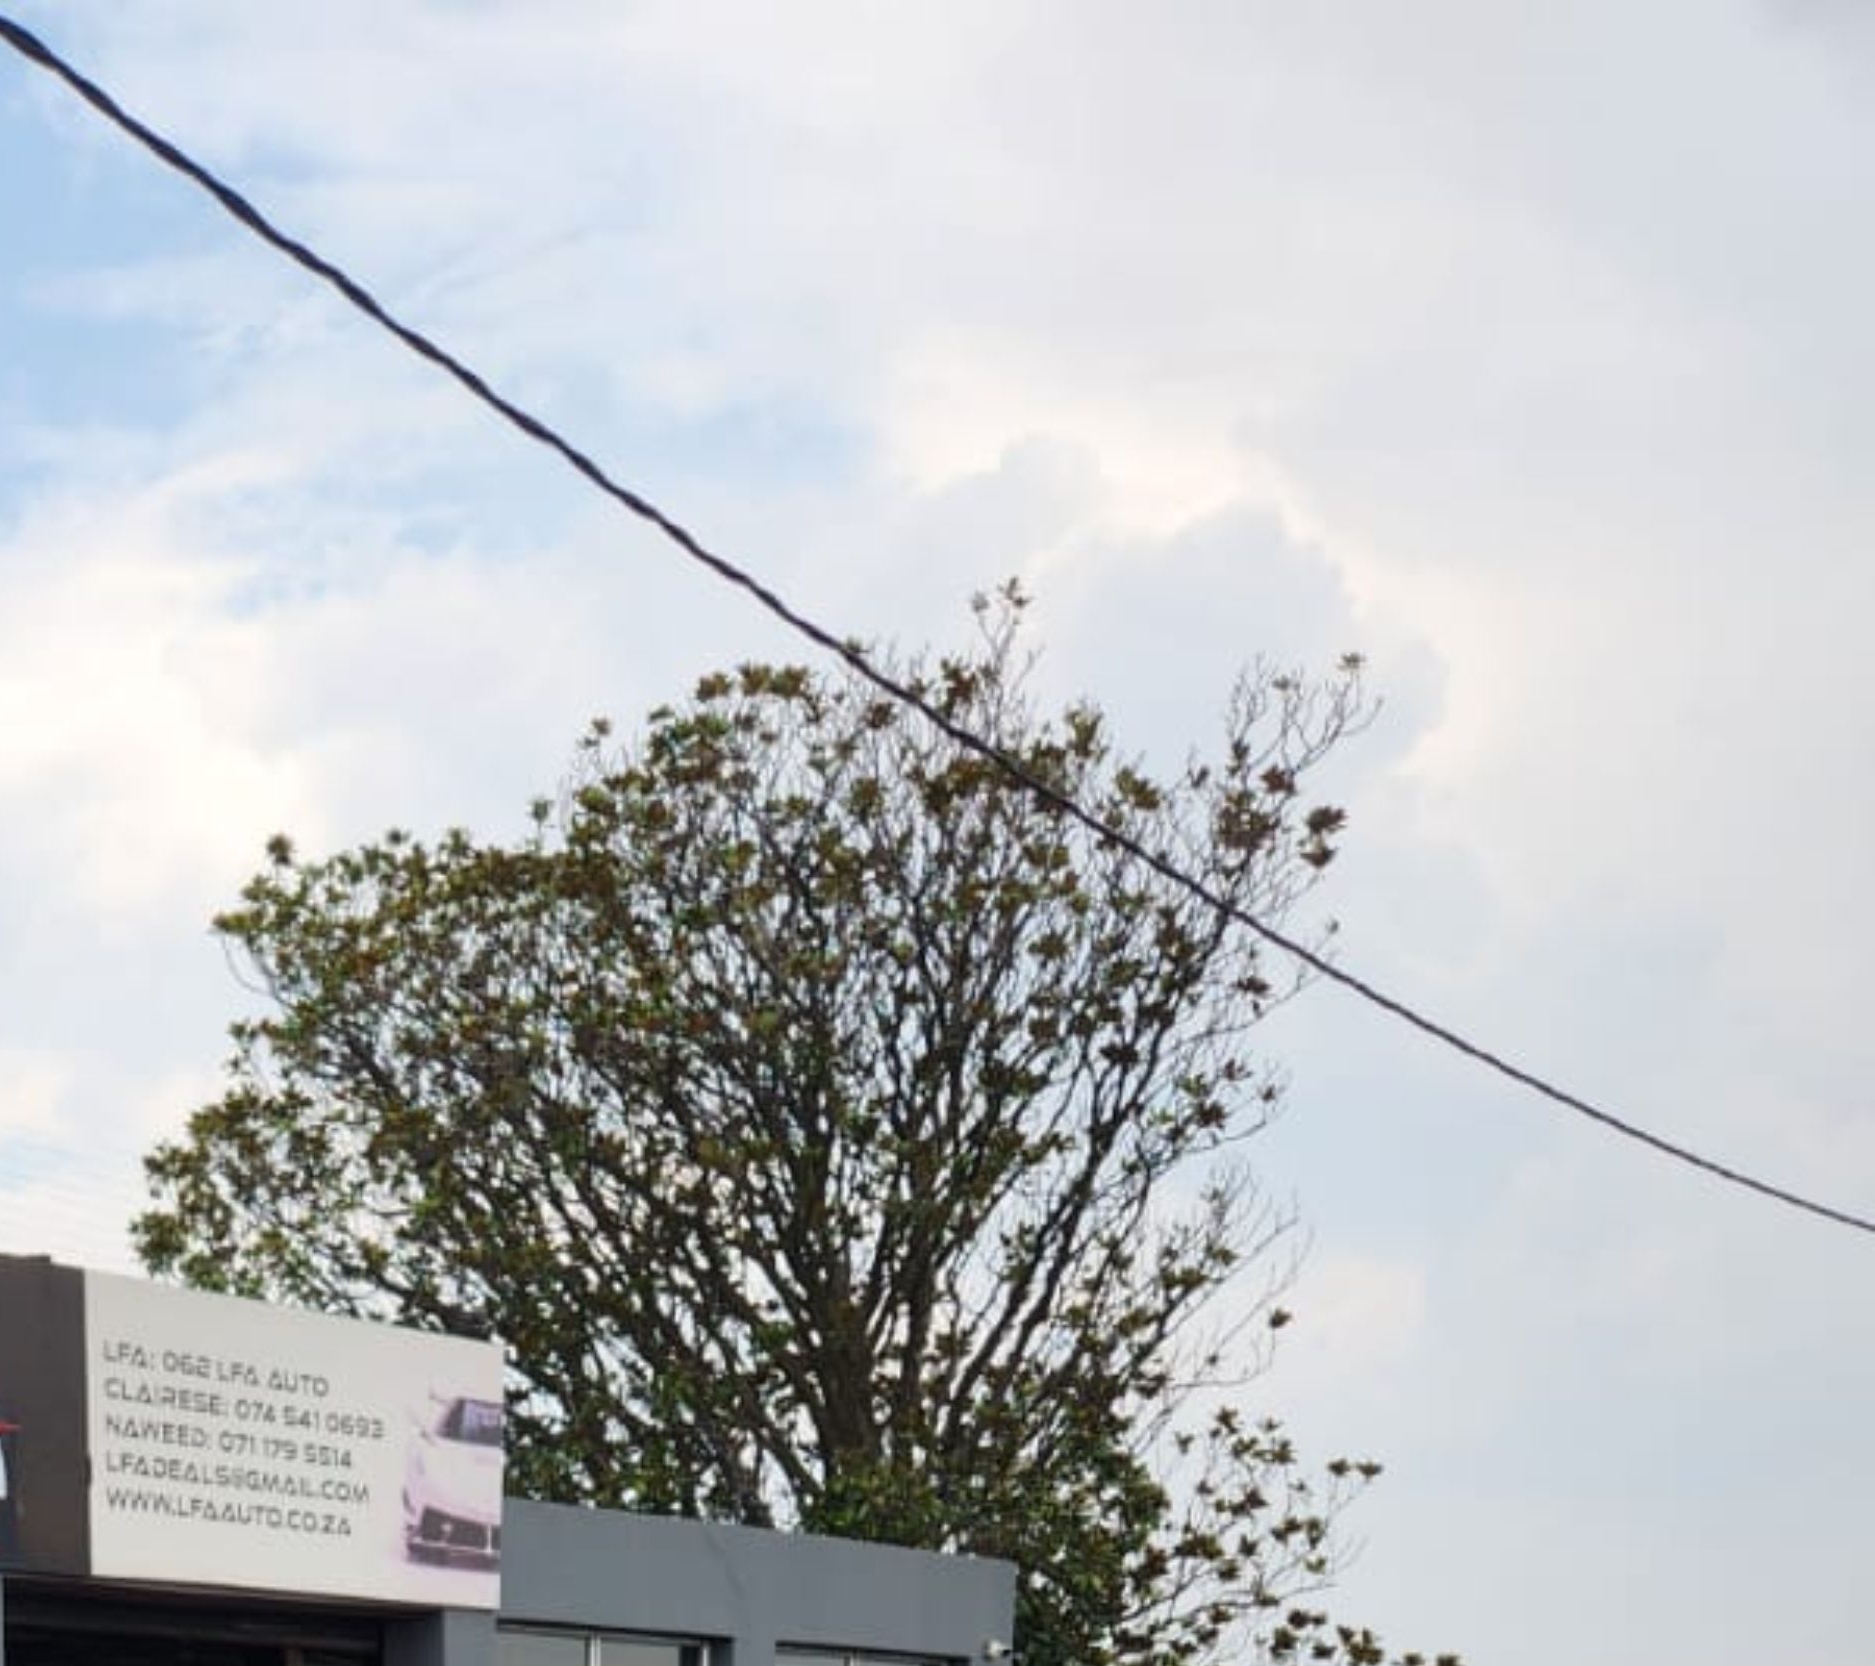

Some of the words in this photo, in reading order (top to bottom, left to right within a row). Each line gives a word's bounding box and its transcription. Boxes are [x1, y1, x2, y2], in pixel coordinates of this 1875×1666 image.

[103, 1339, 155, 1370] LFA:
[162, 1350, 211, 1379] 062
[218, 1360, 260, 1388] LFA
[268, 1369, 331, 1398] AUTO
[234, 1399, 277, 1425] 074
